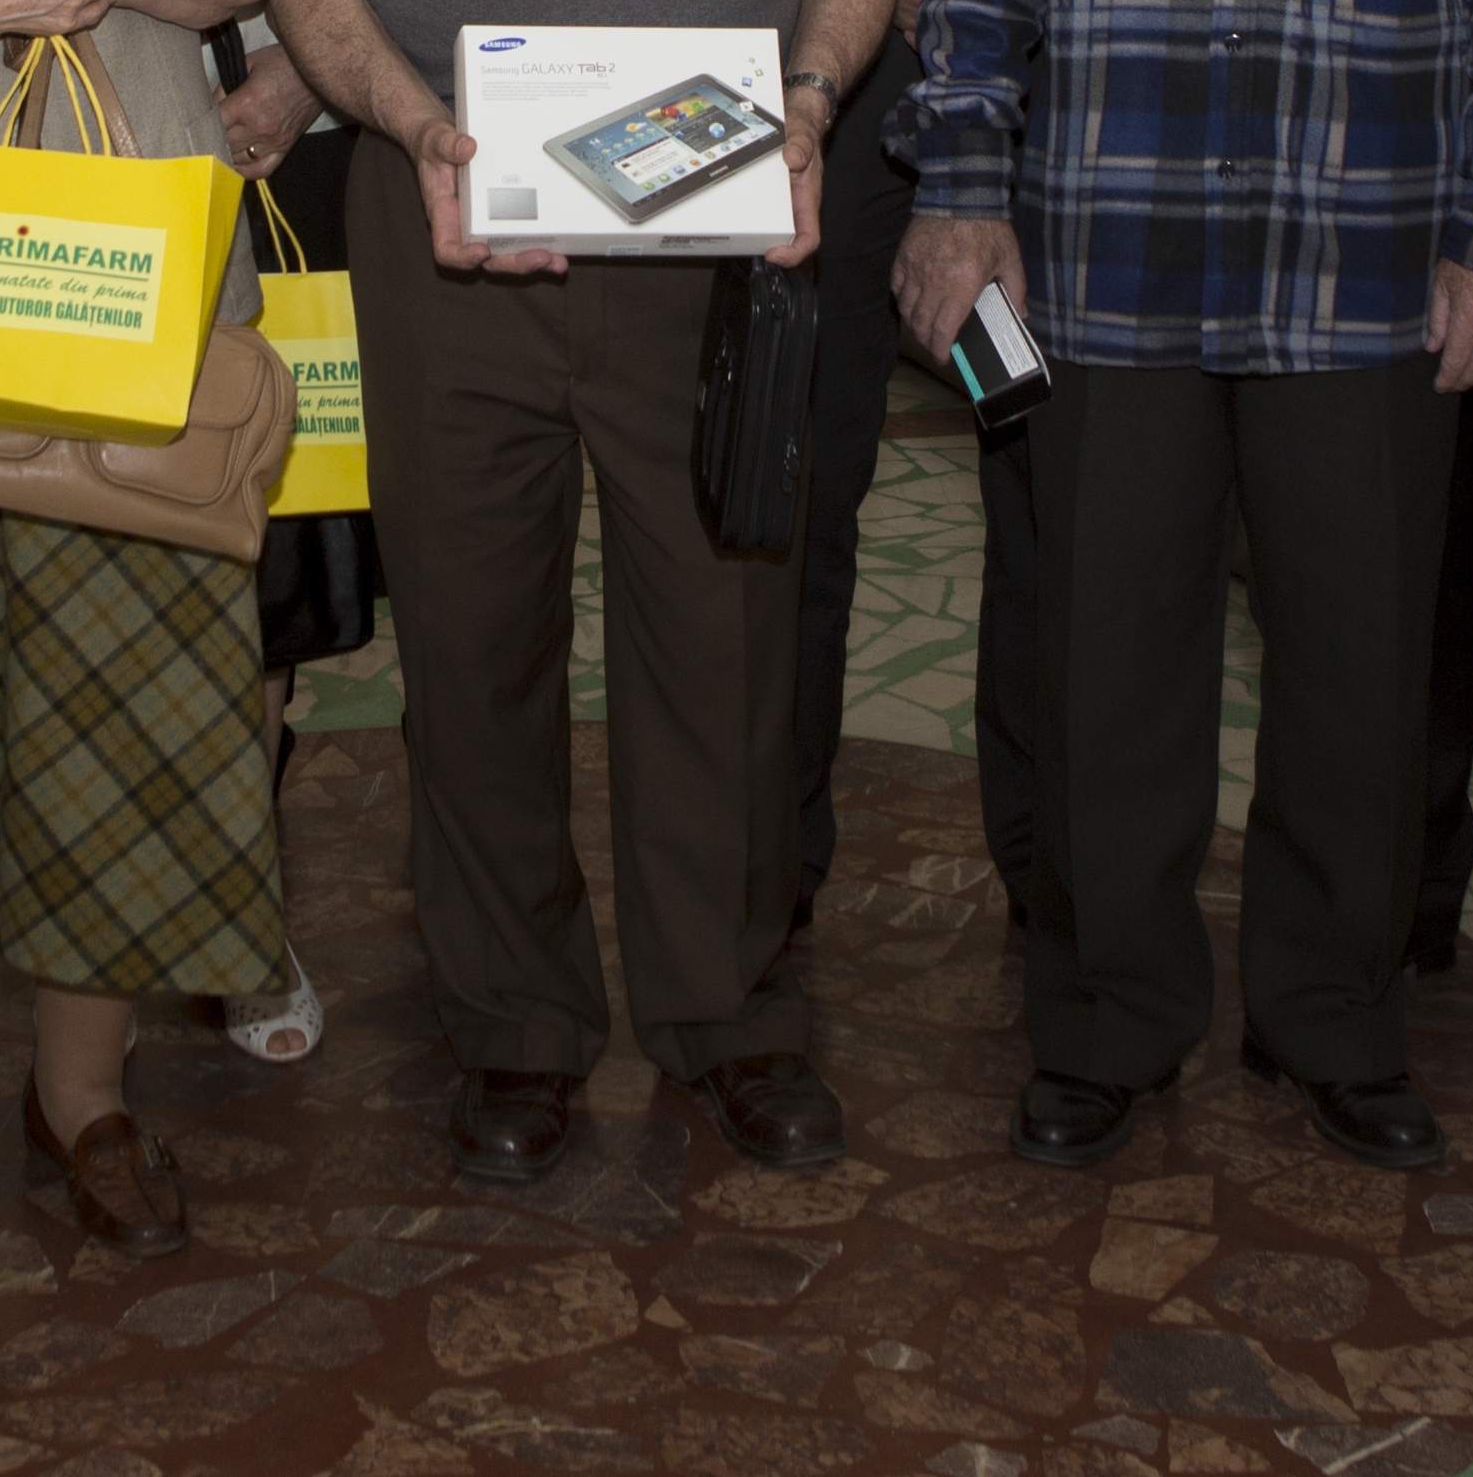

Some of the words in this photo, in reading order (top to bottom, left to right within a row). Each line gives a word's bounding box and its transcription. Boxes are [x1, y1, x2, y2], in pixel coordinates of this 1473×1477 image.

[484, 40, 522, 49] SAMSUNG
[481, 65, 520, 76] Samsung
[522, 63, 574, 75] GALAXY
[577, 61, 607, 74] Tab
[609, 62, 616, 73] 2
[60, 277, 89, 293] din
[93, 282, 149, 302] prima
[317, 394, 361, 411] prima
